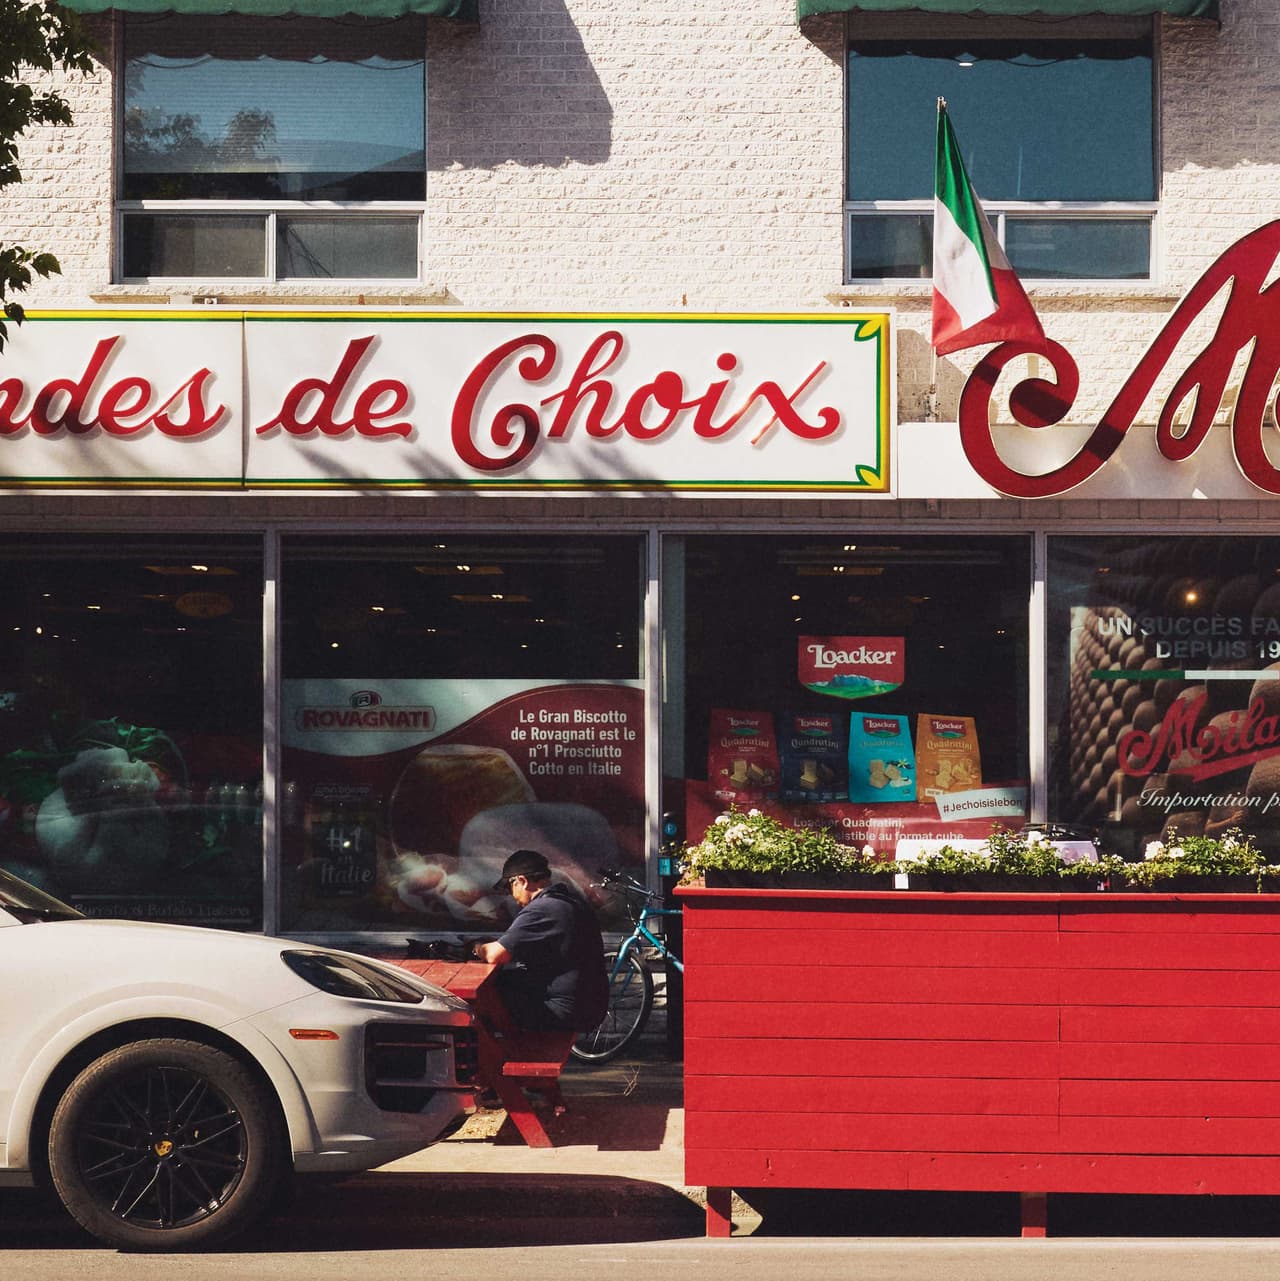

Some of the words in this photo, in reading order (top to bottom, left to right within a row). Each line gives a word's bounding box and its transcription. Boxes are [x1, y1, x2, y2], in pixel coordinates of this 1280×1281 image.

[255, 334, 413, 438] de
[451, 330, 840, 473] Choix
[1098, 616, 1132, 636] UN
[1141, 612, 1241, 637] SUCCÈS
[807, 645, 896, 669] Loacker
[1156, 639, 1247, 659] DEPUIS
[303, 709, 430, 729] ROVAGNATI
[520, 709, 535, 723] Le
[539, 709, 570, 723] Gran
[574, 709, 627, 723] Biscotto
[511, 727, 527, 741] de
[531, 727, 595, 743] Rovagnati
[599, 728, 619, 741] est
[624, 727, 636, 741] le
[529, 744, 550, 757] n°1
[555, 744, 622, 757] Prosciutto
[530, 761, 564, 775] Cotto
[568, 765, 584, 775] en
[588, 761, 622, 775] Italie
[943, 798, 1023, 813] #Jechoisislebon
[1136, 787, 1261, 814] Importation
[842, 817, 904, 829] Quadratini,
[878, 832, 892, 841] au
[895, 831, 933, 841] format
